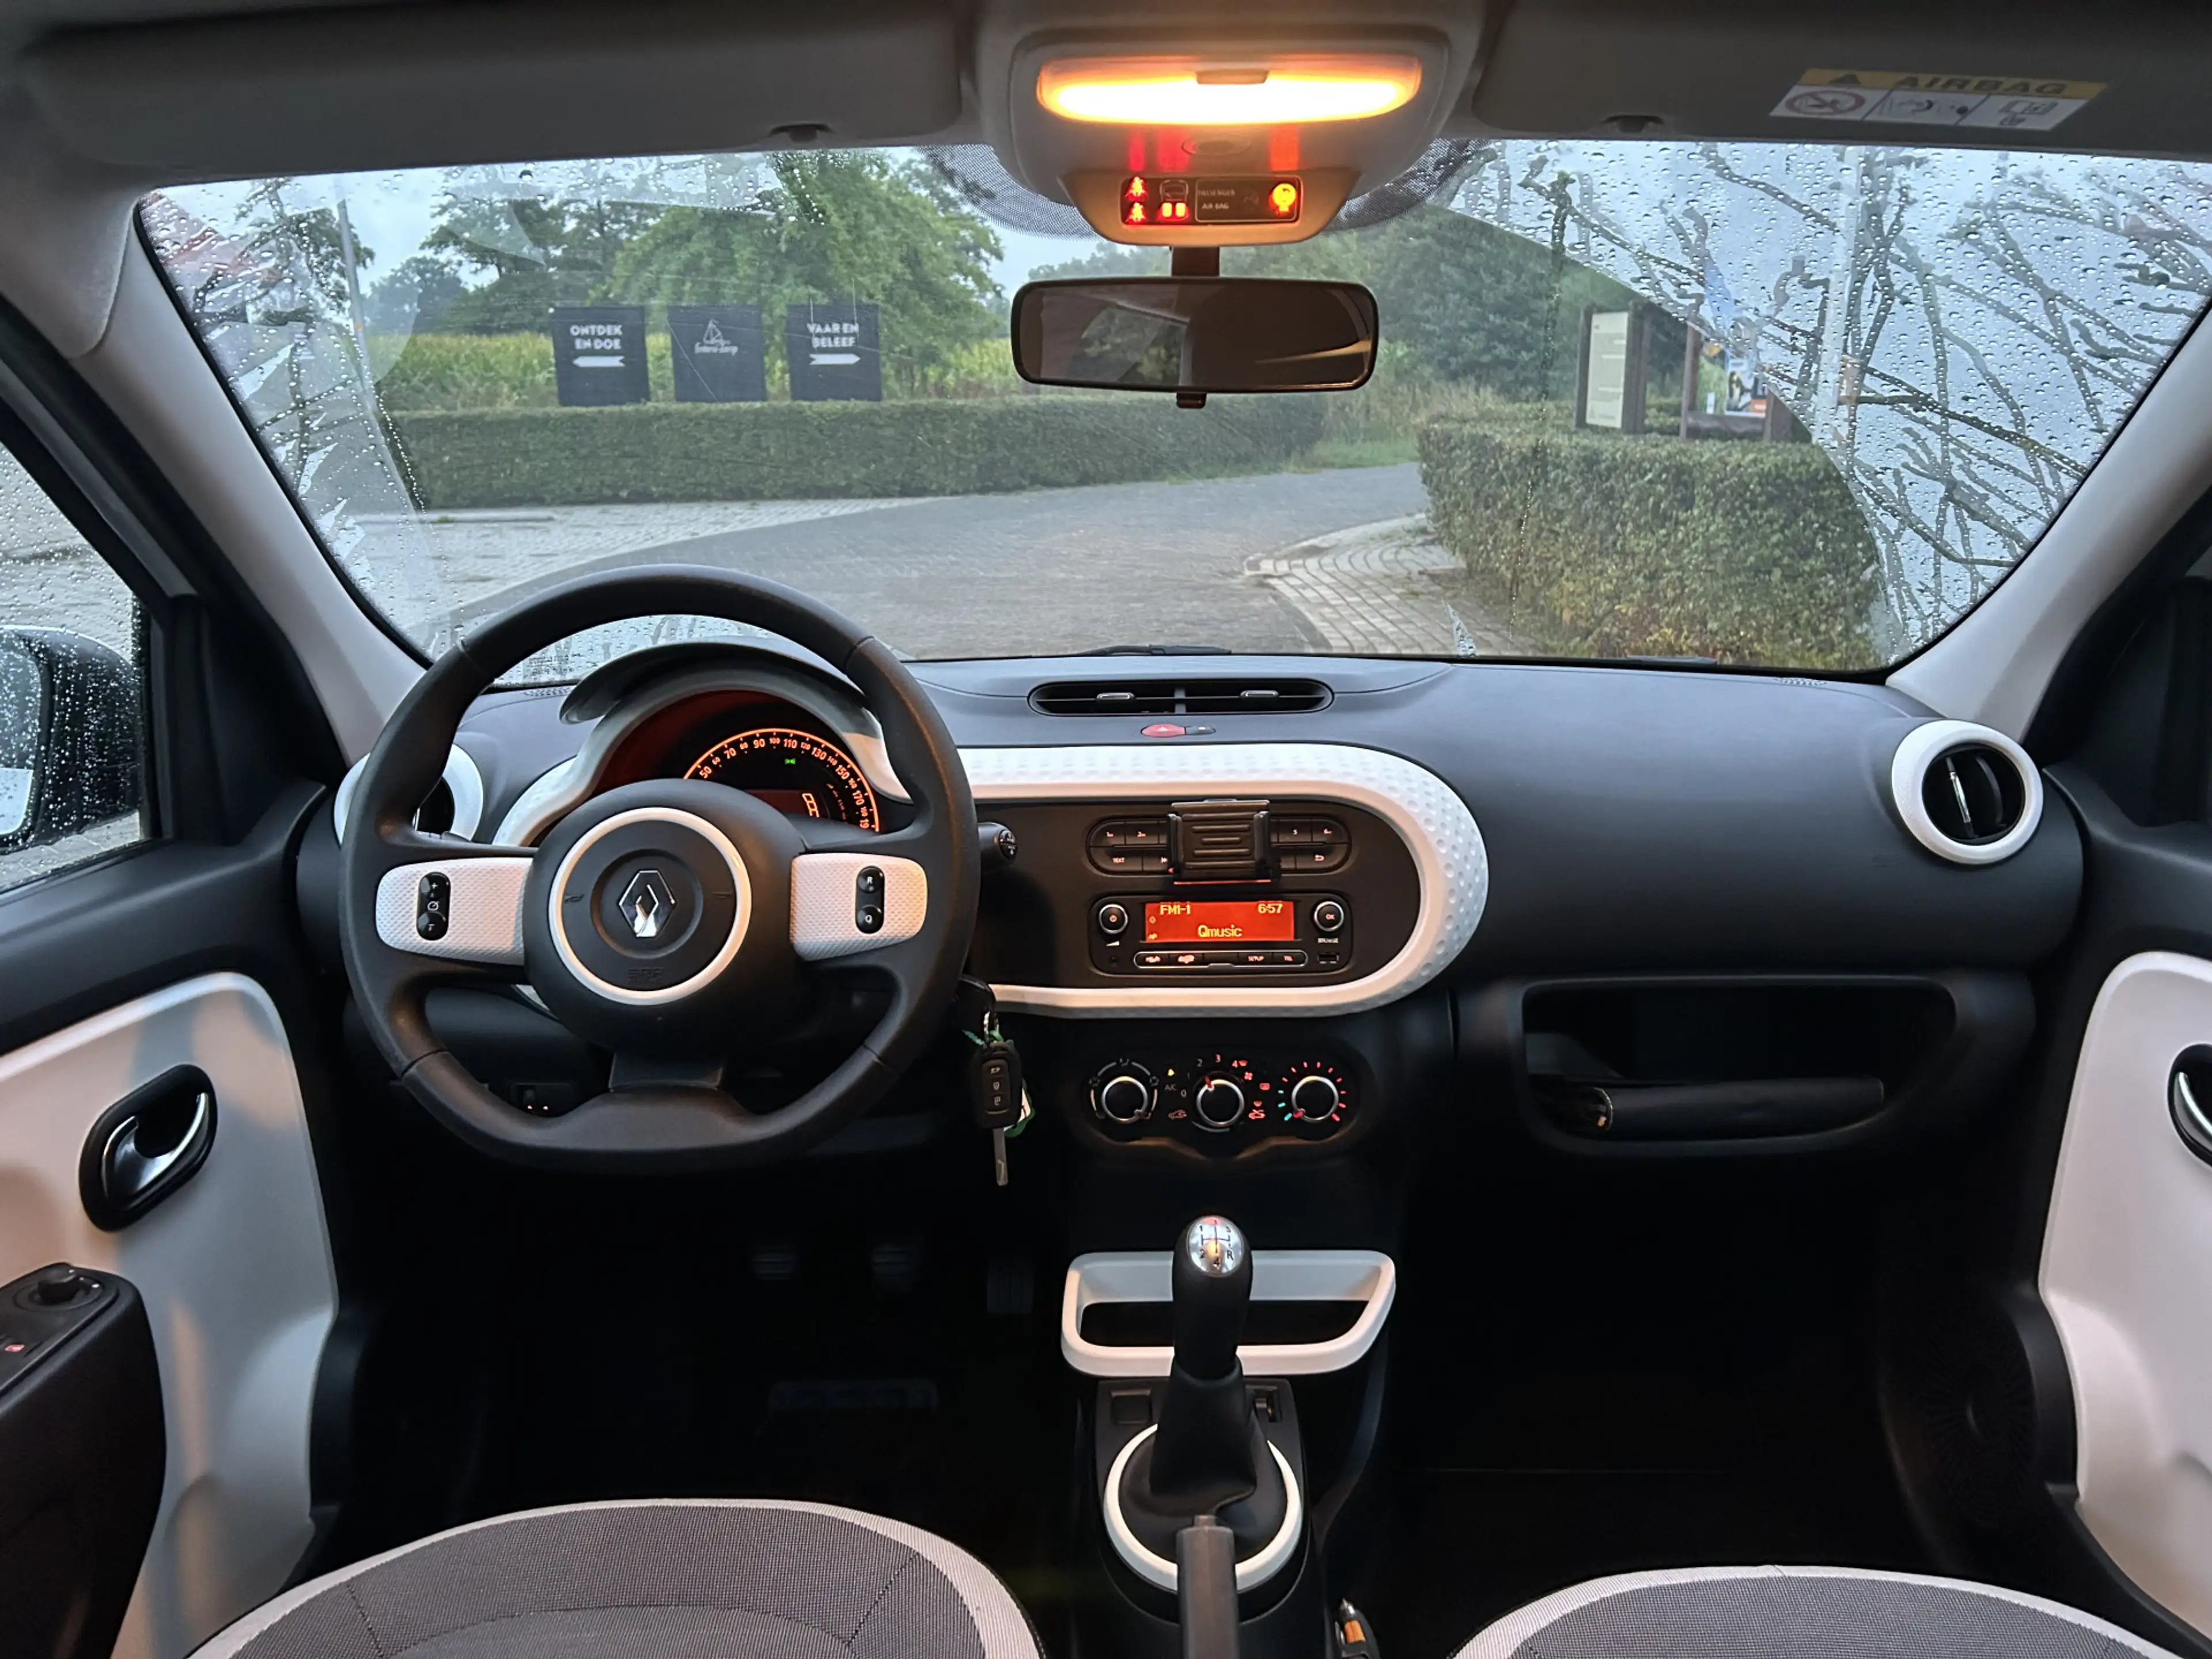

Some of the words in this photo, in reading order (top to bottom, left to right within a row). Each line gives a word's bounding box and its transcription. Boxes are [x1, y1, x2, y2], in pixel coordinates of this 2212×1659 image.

[1895, 75, 2069, 94] AIRBAG
[570, 325, 622, 336] ONTDEK
[806, 323, 841, 334] VAAR
[842, 323, 859, 334] EN
[575, 338, 592, 350] EN
[593, 338, 622, 350] DOE
[811, 337, 855, 347] BELEEF
[753, 738, 766, 749] 90
[783, 738, 797, 748] 110
[724, 748, 737, 759] 70
[811, 747, 827, 760] 130
[699, 766, 713, 778] 50
[835, 764, 850, 779] 150
[853, 790, 865, 805] 170
[867, 876, 873, 884] R
[1198, 924, 1243, 938] Qmusic
[1196, 1058, 1203, 1067] 2
[1215, 1054, 1222, 1063] 3
[1232, 1059, 1238, 1068] 4
[1199, 1249, 1205, 1259] 2
[1227, 1249, 1234, 1261] R
[1213, 1257, 1220, 1266] 4
